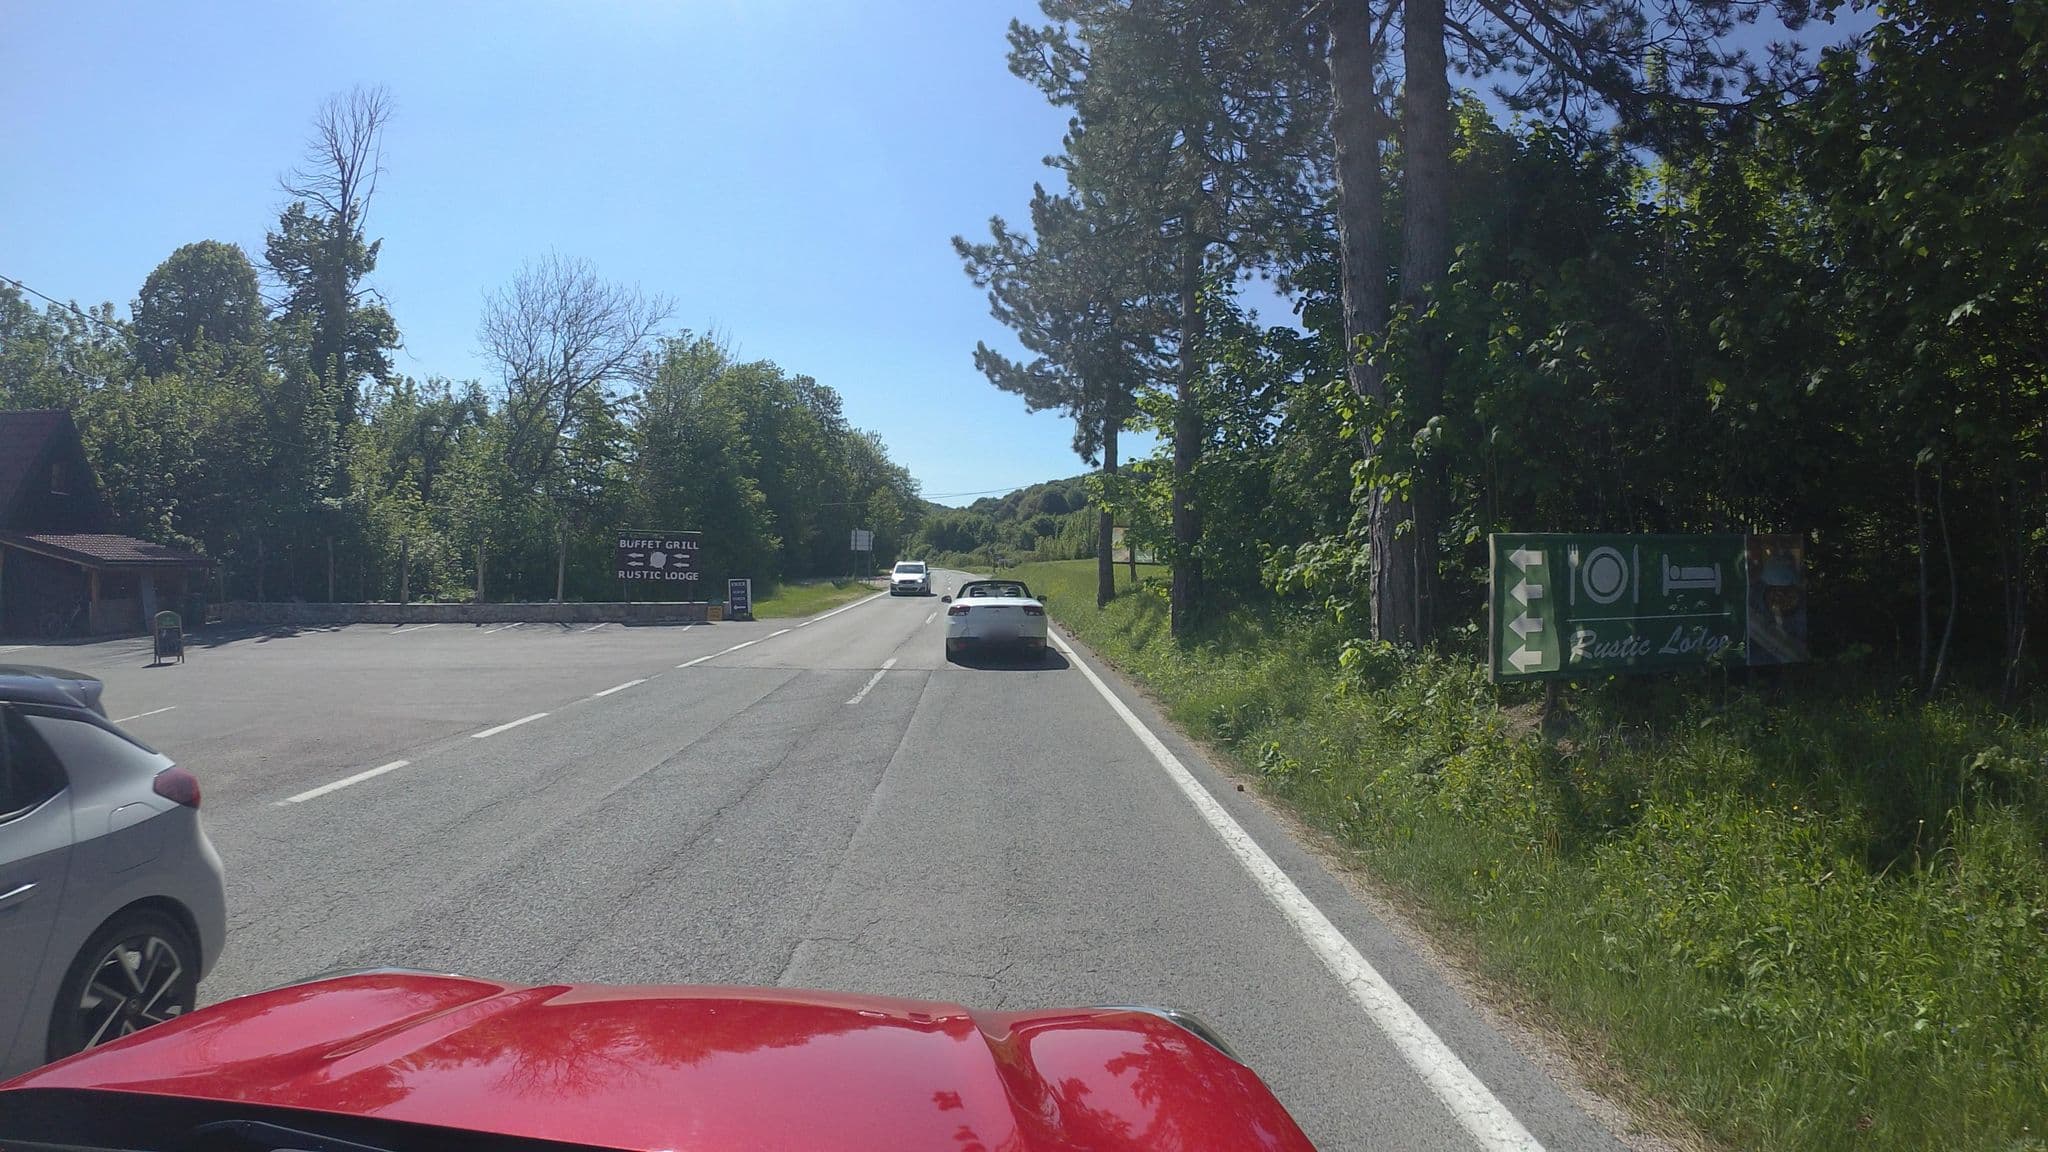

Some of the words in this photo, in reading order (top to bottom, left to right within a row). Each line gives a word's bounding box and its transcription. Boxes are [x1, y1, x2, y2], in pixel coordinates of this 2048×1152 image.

[619, 539, 662, 549] BUFFET
[665, 541, 700, 550] GRILL
[618, 570, 662, 580] RUSTIC
[665, 571, 699, 581] LODGE
[1568, 629, 1651, 664] Rustic
[1658, 625, 1730, 660] Lodge
